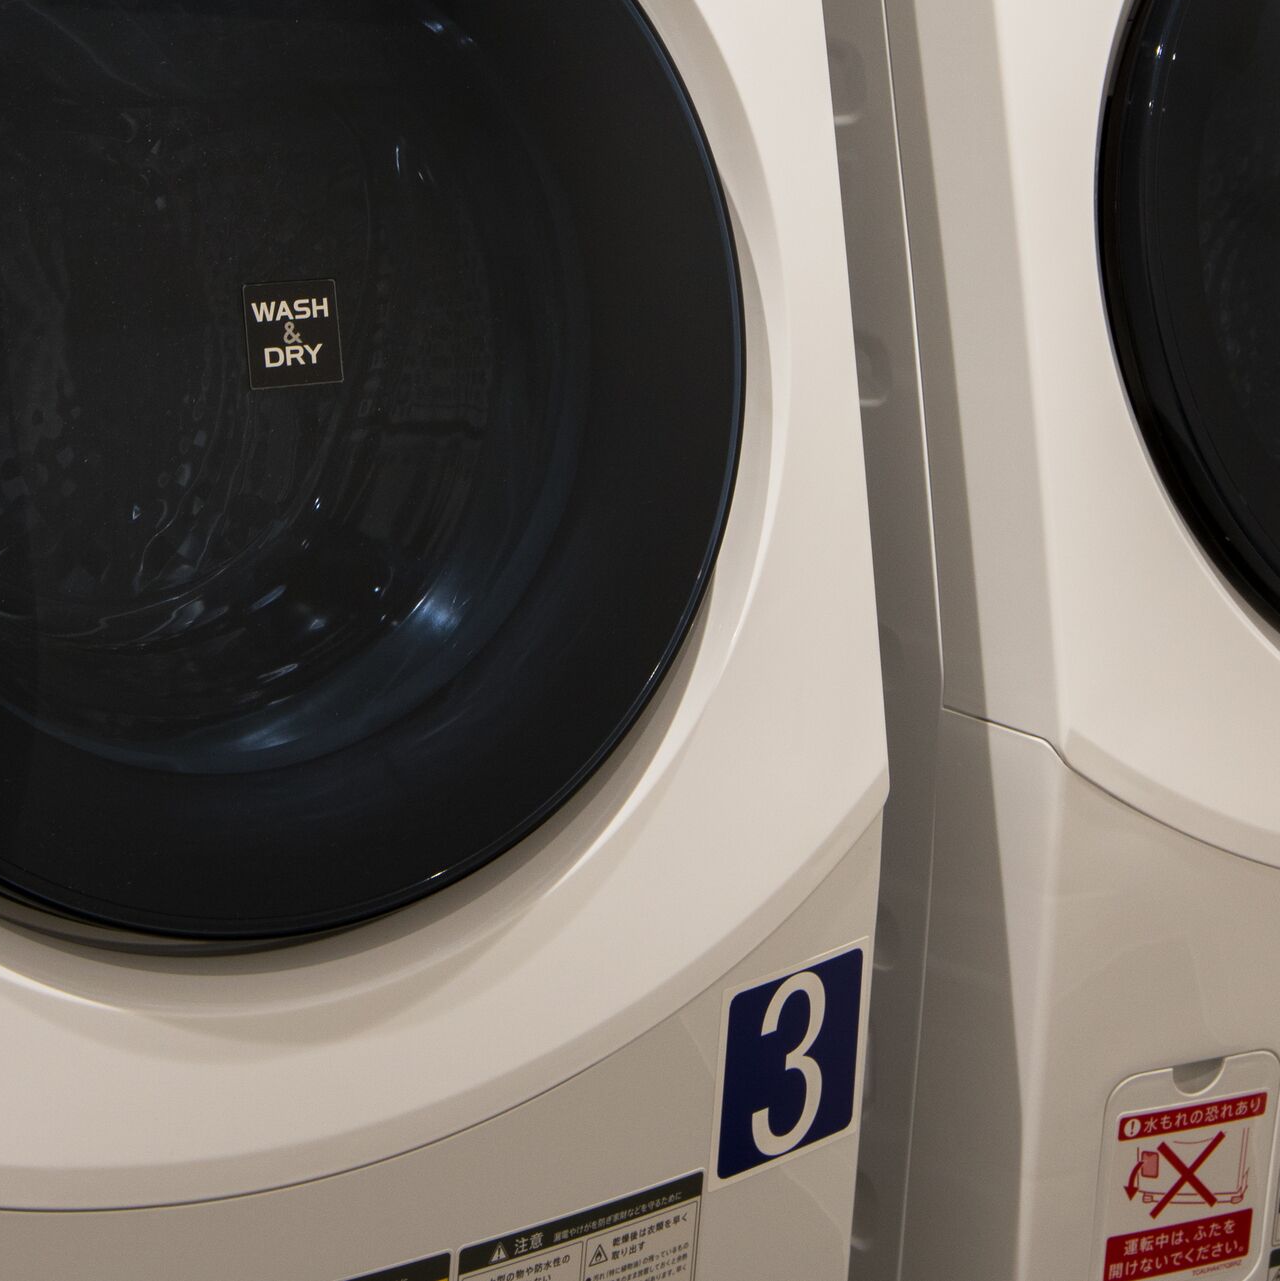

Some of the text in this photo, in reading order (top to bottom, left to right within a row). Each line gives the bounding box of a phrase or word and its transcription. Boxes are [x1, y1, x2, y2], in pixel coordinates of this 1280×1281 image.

[251, 297, 329, 323] WASH
[283, 321, 303, 344] &
[264, 343, 323, 368] DRY
[751, 971, 826, 1157] 3
[1144, 1098, 1262, 1133] 水もれの恐れあり
[514, 1232, 544, 1255] 注意
